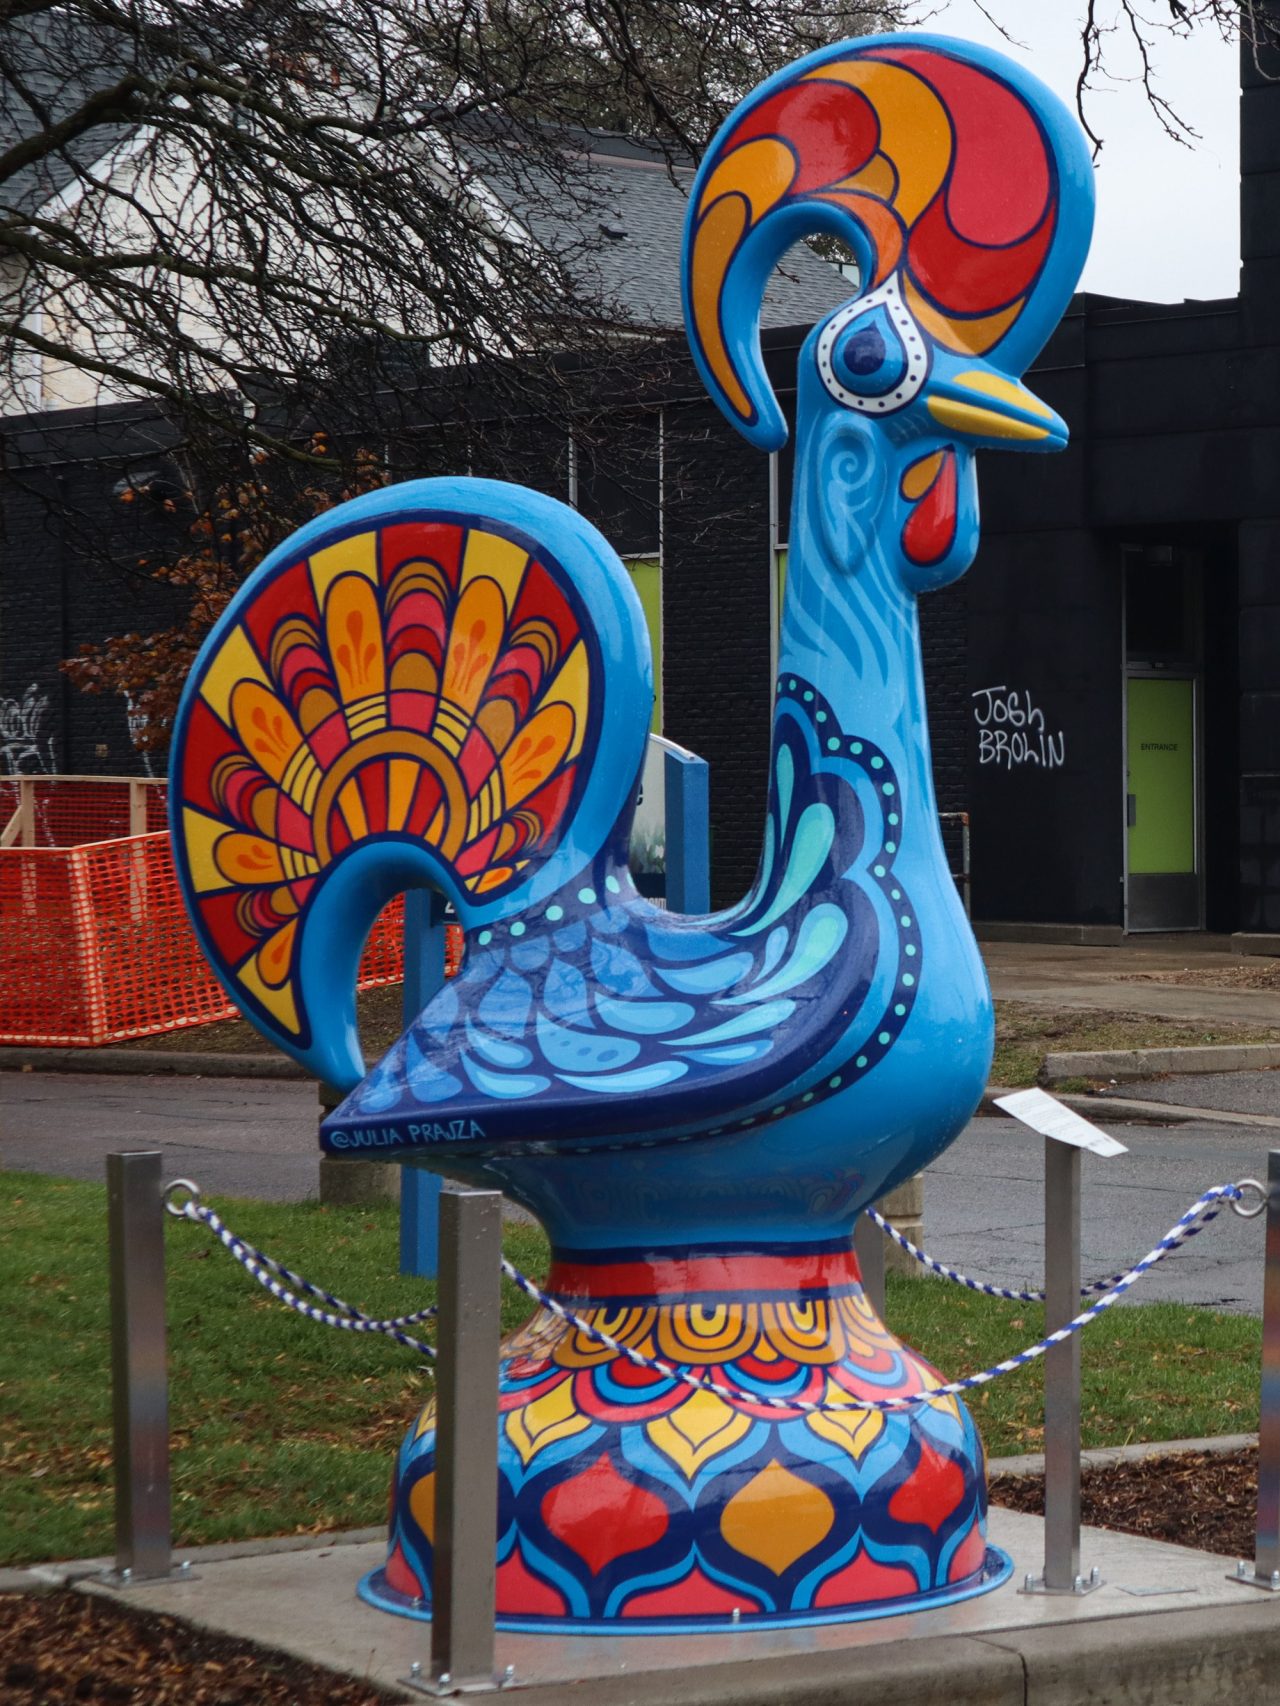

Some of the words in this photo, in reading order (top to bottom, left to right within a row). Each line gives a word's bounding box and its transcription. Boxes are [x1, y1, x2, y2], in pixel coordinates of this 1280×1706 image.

[1140, 743, 1178, 751] ENTRANCE
[329, 1127, 403, 1149] @JULIA
[408, 1119, 486, 1144] PRAJZA
